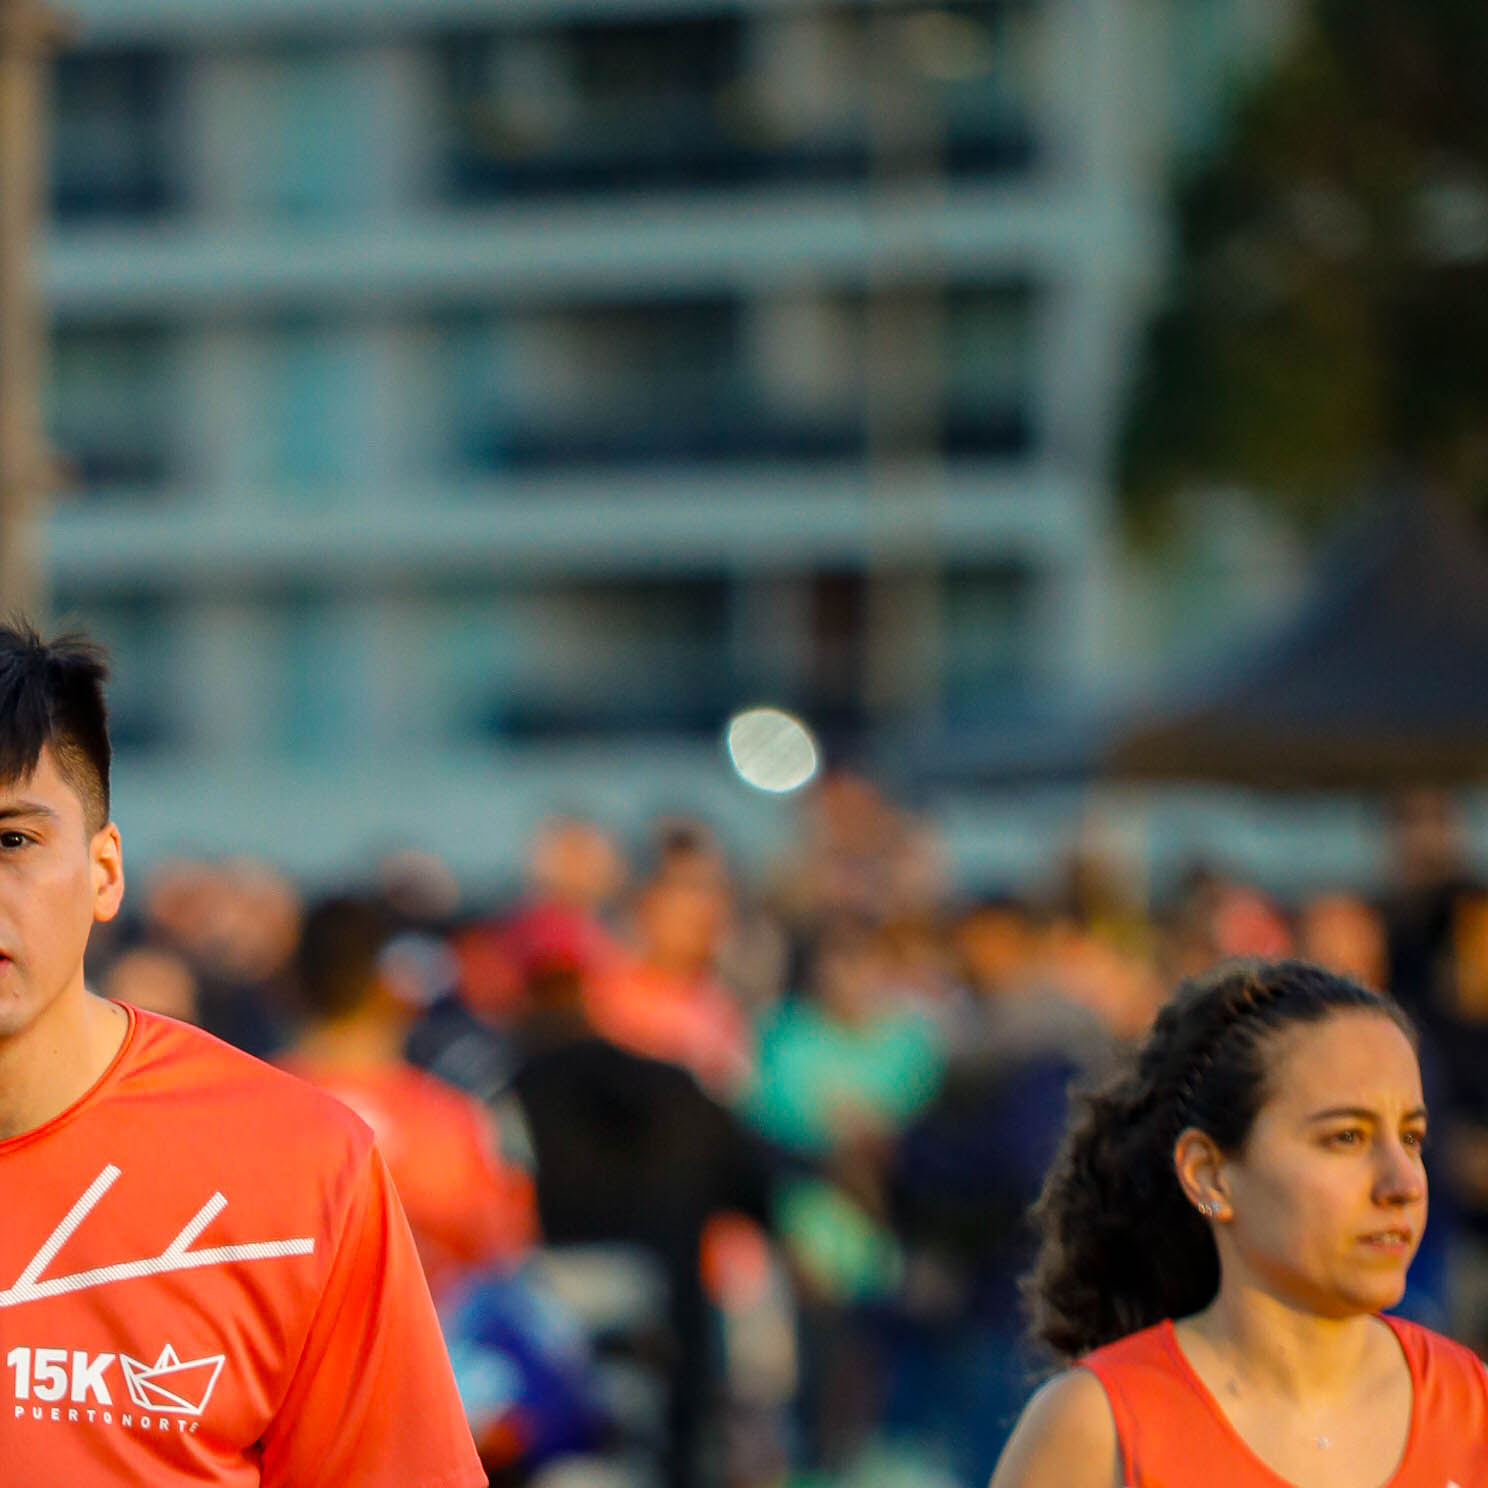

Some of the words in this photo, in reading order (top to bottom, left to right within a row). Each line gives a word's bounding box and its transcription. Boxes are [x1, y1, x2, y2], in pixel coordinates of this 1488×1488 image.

[8, 1347, 115, 1405] 15K
[14, 1405, 112, 1425] PUERTO
[121, 1414, 199, 1433] NORTE
